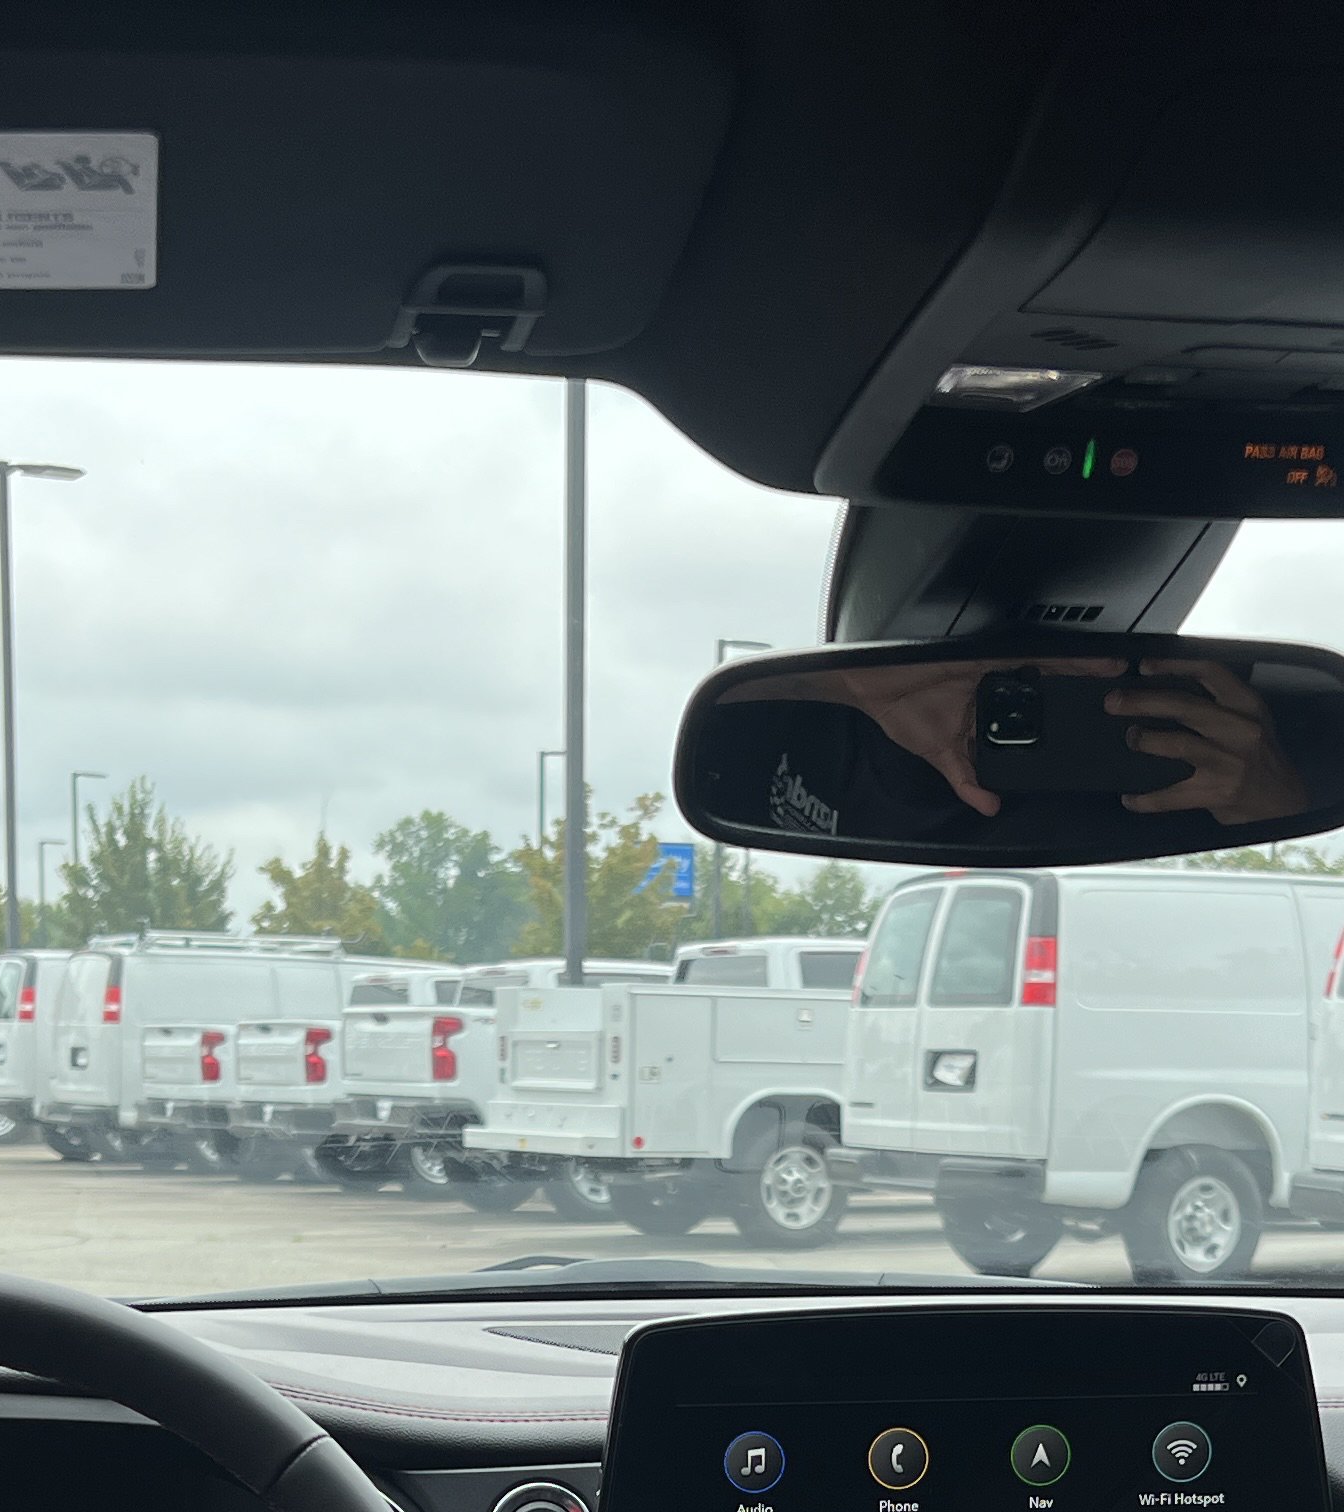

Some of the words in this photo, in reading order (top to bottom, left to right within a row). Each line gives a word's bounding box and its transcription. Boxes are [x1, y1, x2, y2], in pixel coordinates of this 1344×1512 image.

[1286, 471, 1310, 484] OFF
[1195, 1372, 1208, 1382] 4G
[1209, 1372, 1227, 1381] LTE
[878, 1500, 919, 1512] Phone
[1029, 1496, 1054, 1509] Nav
[1138, 1492, 1172, 1506] Wi-Fi
[1174, 1492, 1225, 1508] Hotspot
